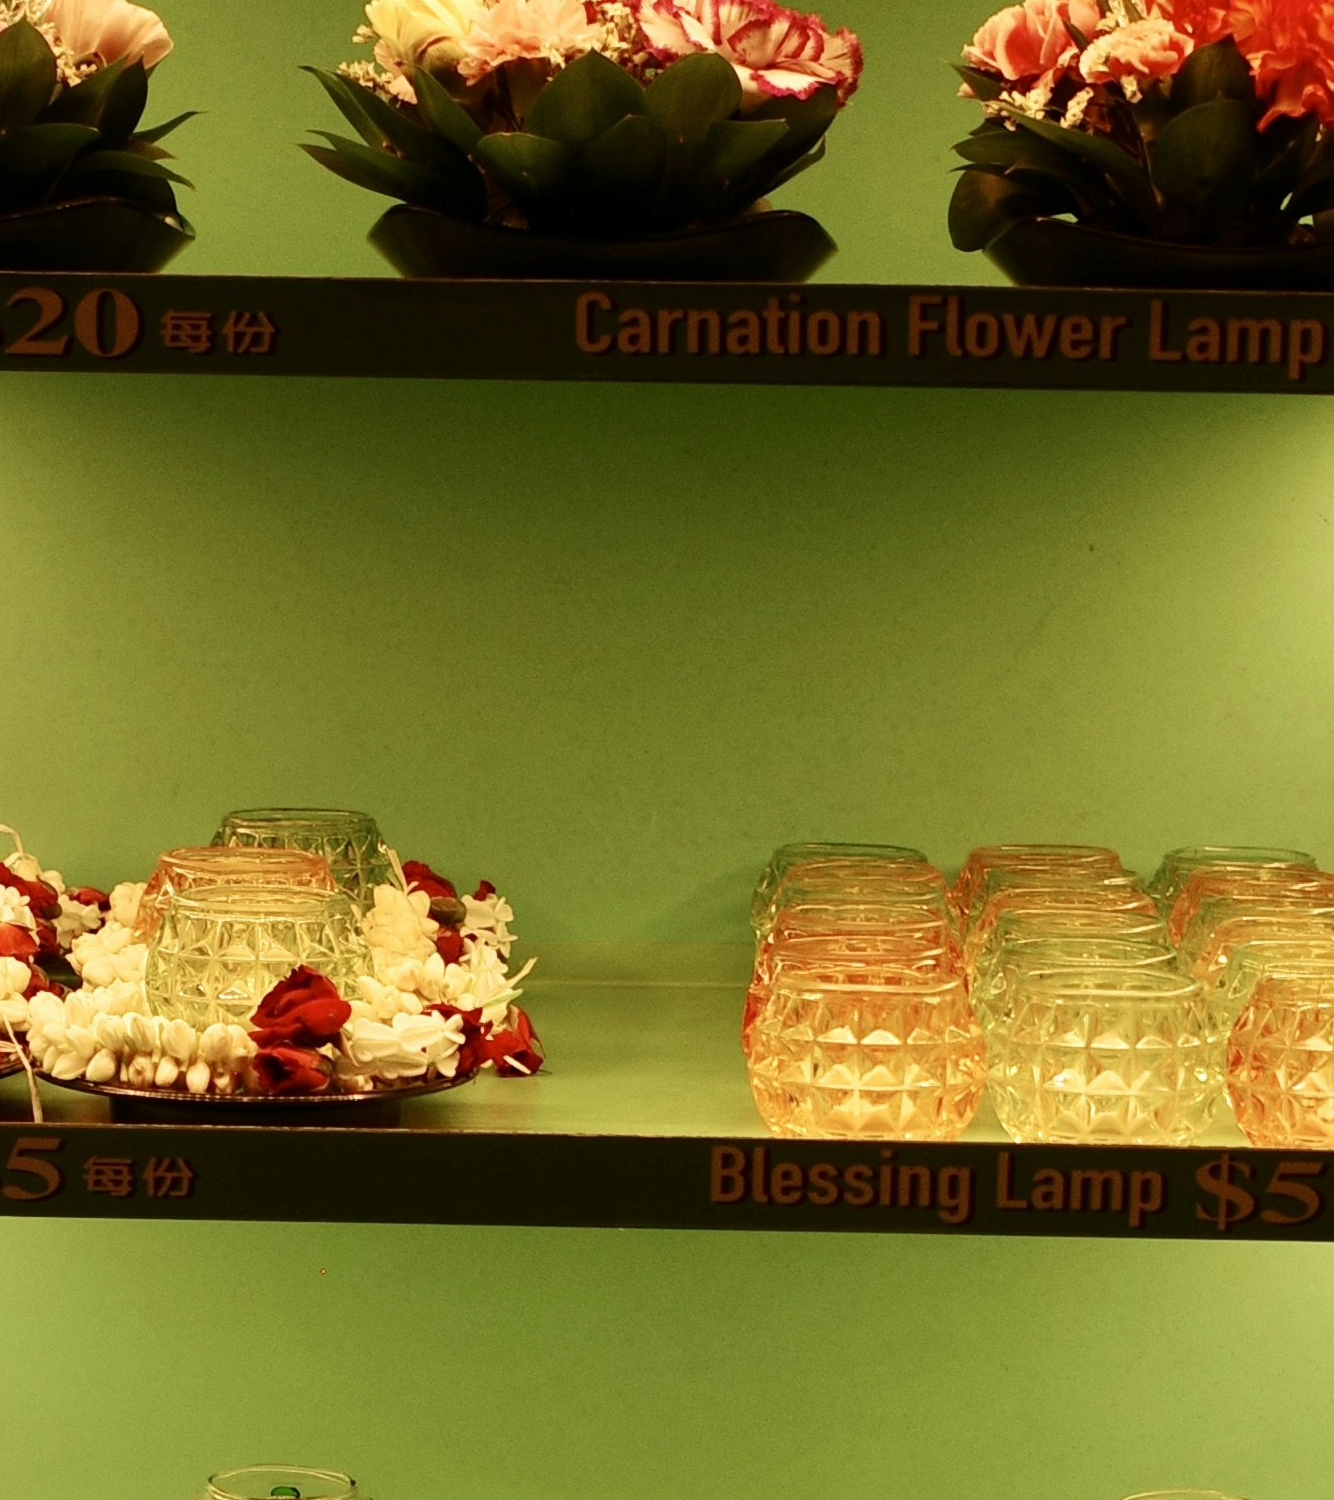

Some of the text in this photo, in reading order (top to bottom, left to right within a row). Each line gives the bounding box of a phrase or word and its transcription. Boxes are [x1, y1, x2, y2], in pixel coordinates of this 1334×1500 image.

[158, 308, 280, 359] 每份
[573, 290, 884, 361] Carnation
[906, 296, 1130, 364] Flower
[1148, 303, 1327, 379] Lamp
[83, 1156, 197, 1201] 每份
[708, 1145, 976, 1226] Blessing
[995, 1152, 1168, 1229] Lamp
[1194, 1154, 1331, 1232] $5
